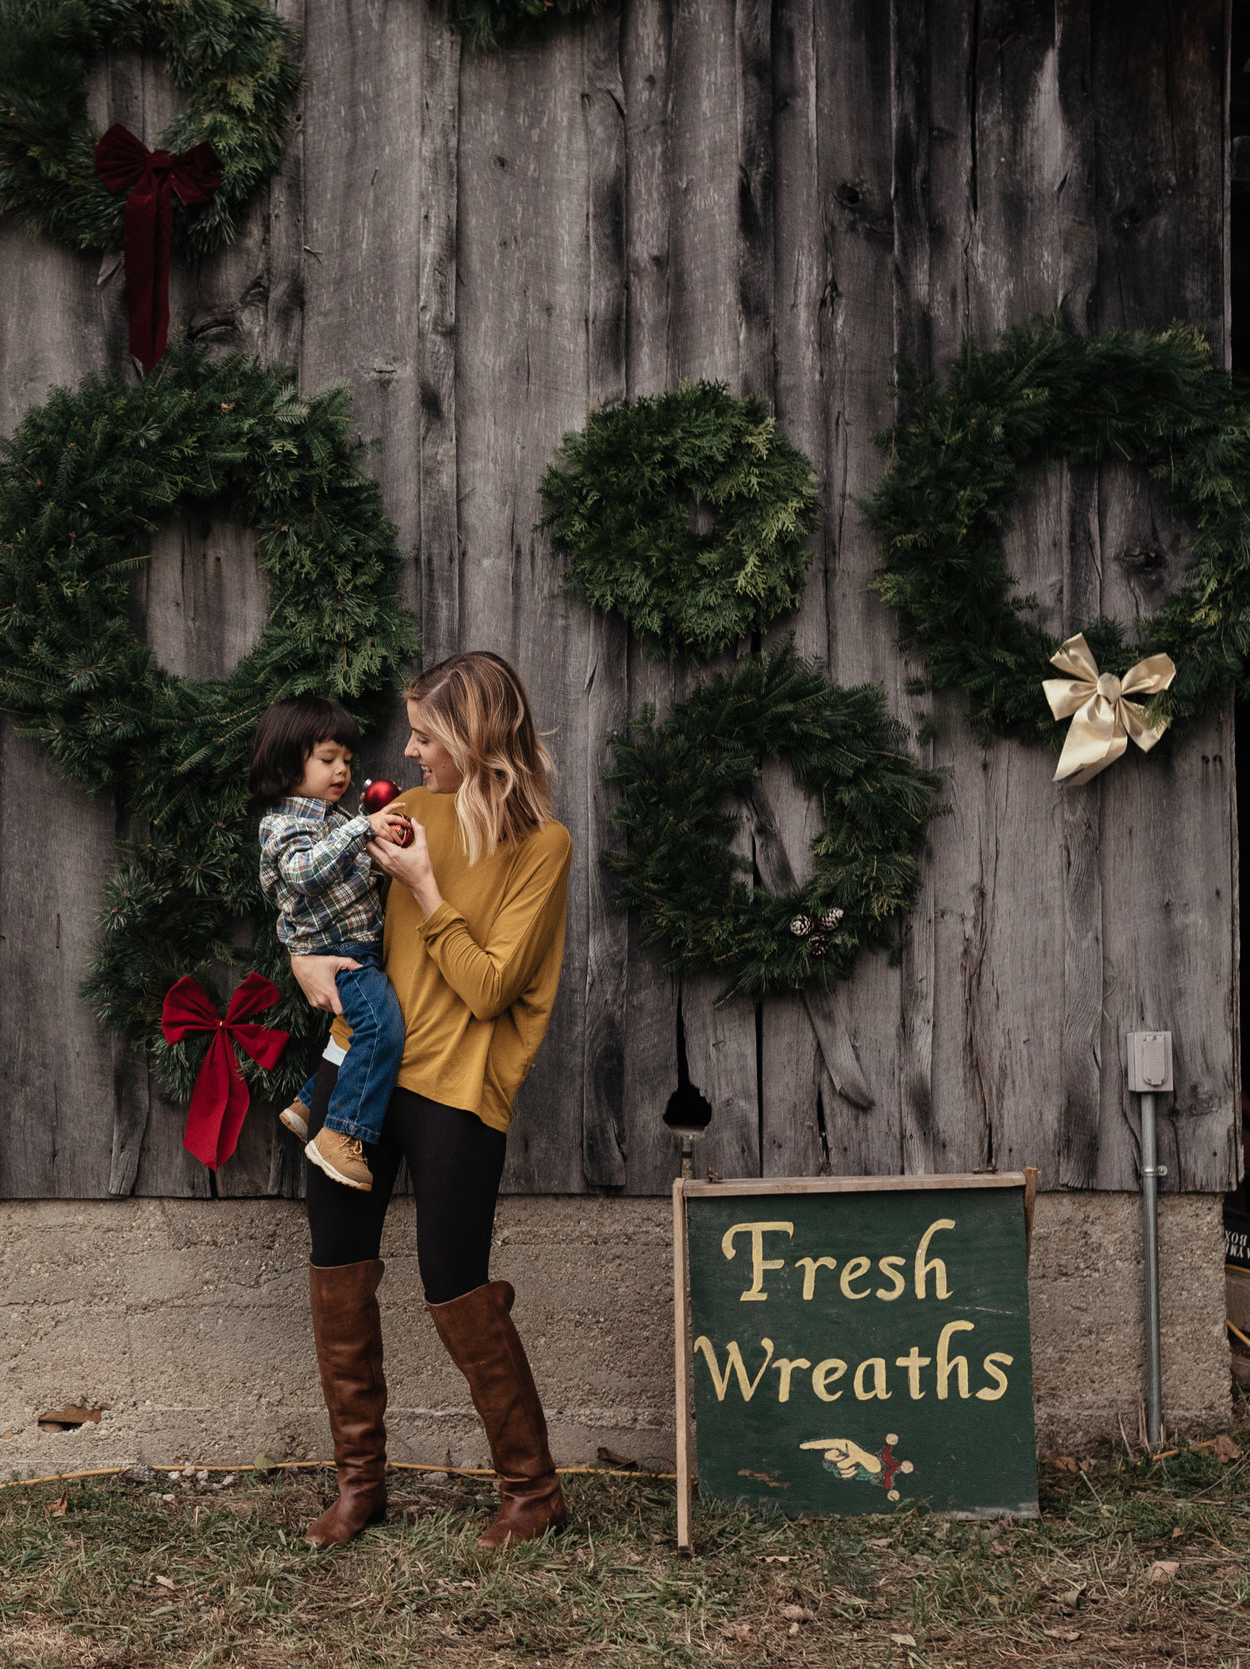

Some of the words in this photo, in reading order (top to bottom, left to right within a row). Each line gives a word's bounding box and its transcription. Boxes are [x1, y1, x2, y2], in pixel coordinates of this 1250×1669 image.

[721, 1218, 956, 1302] Fresh
[1224, 1230, 1248, 1247] BOX
[693, 1319, 1014, 1403] Wreaths
